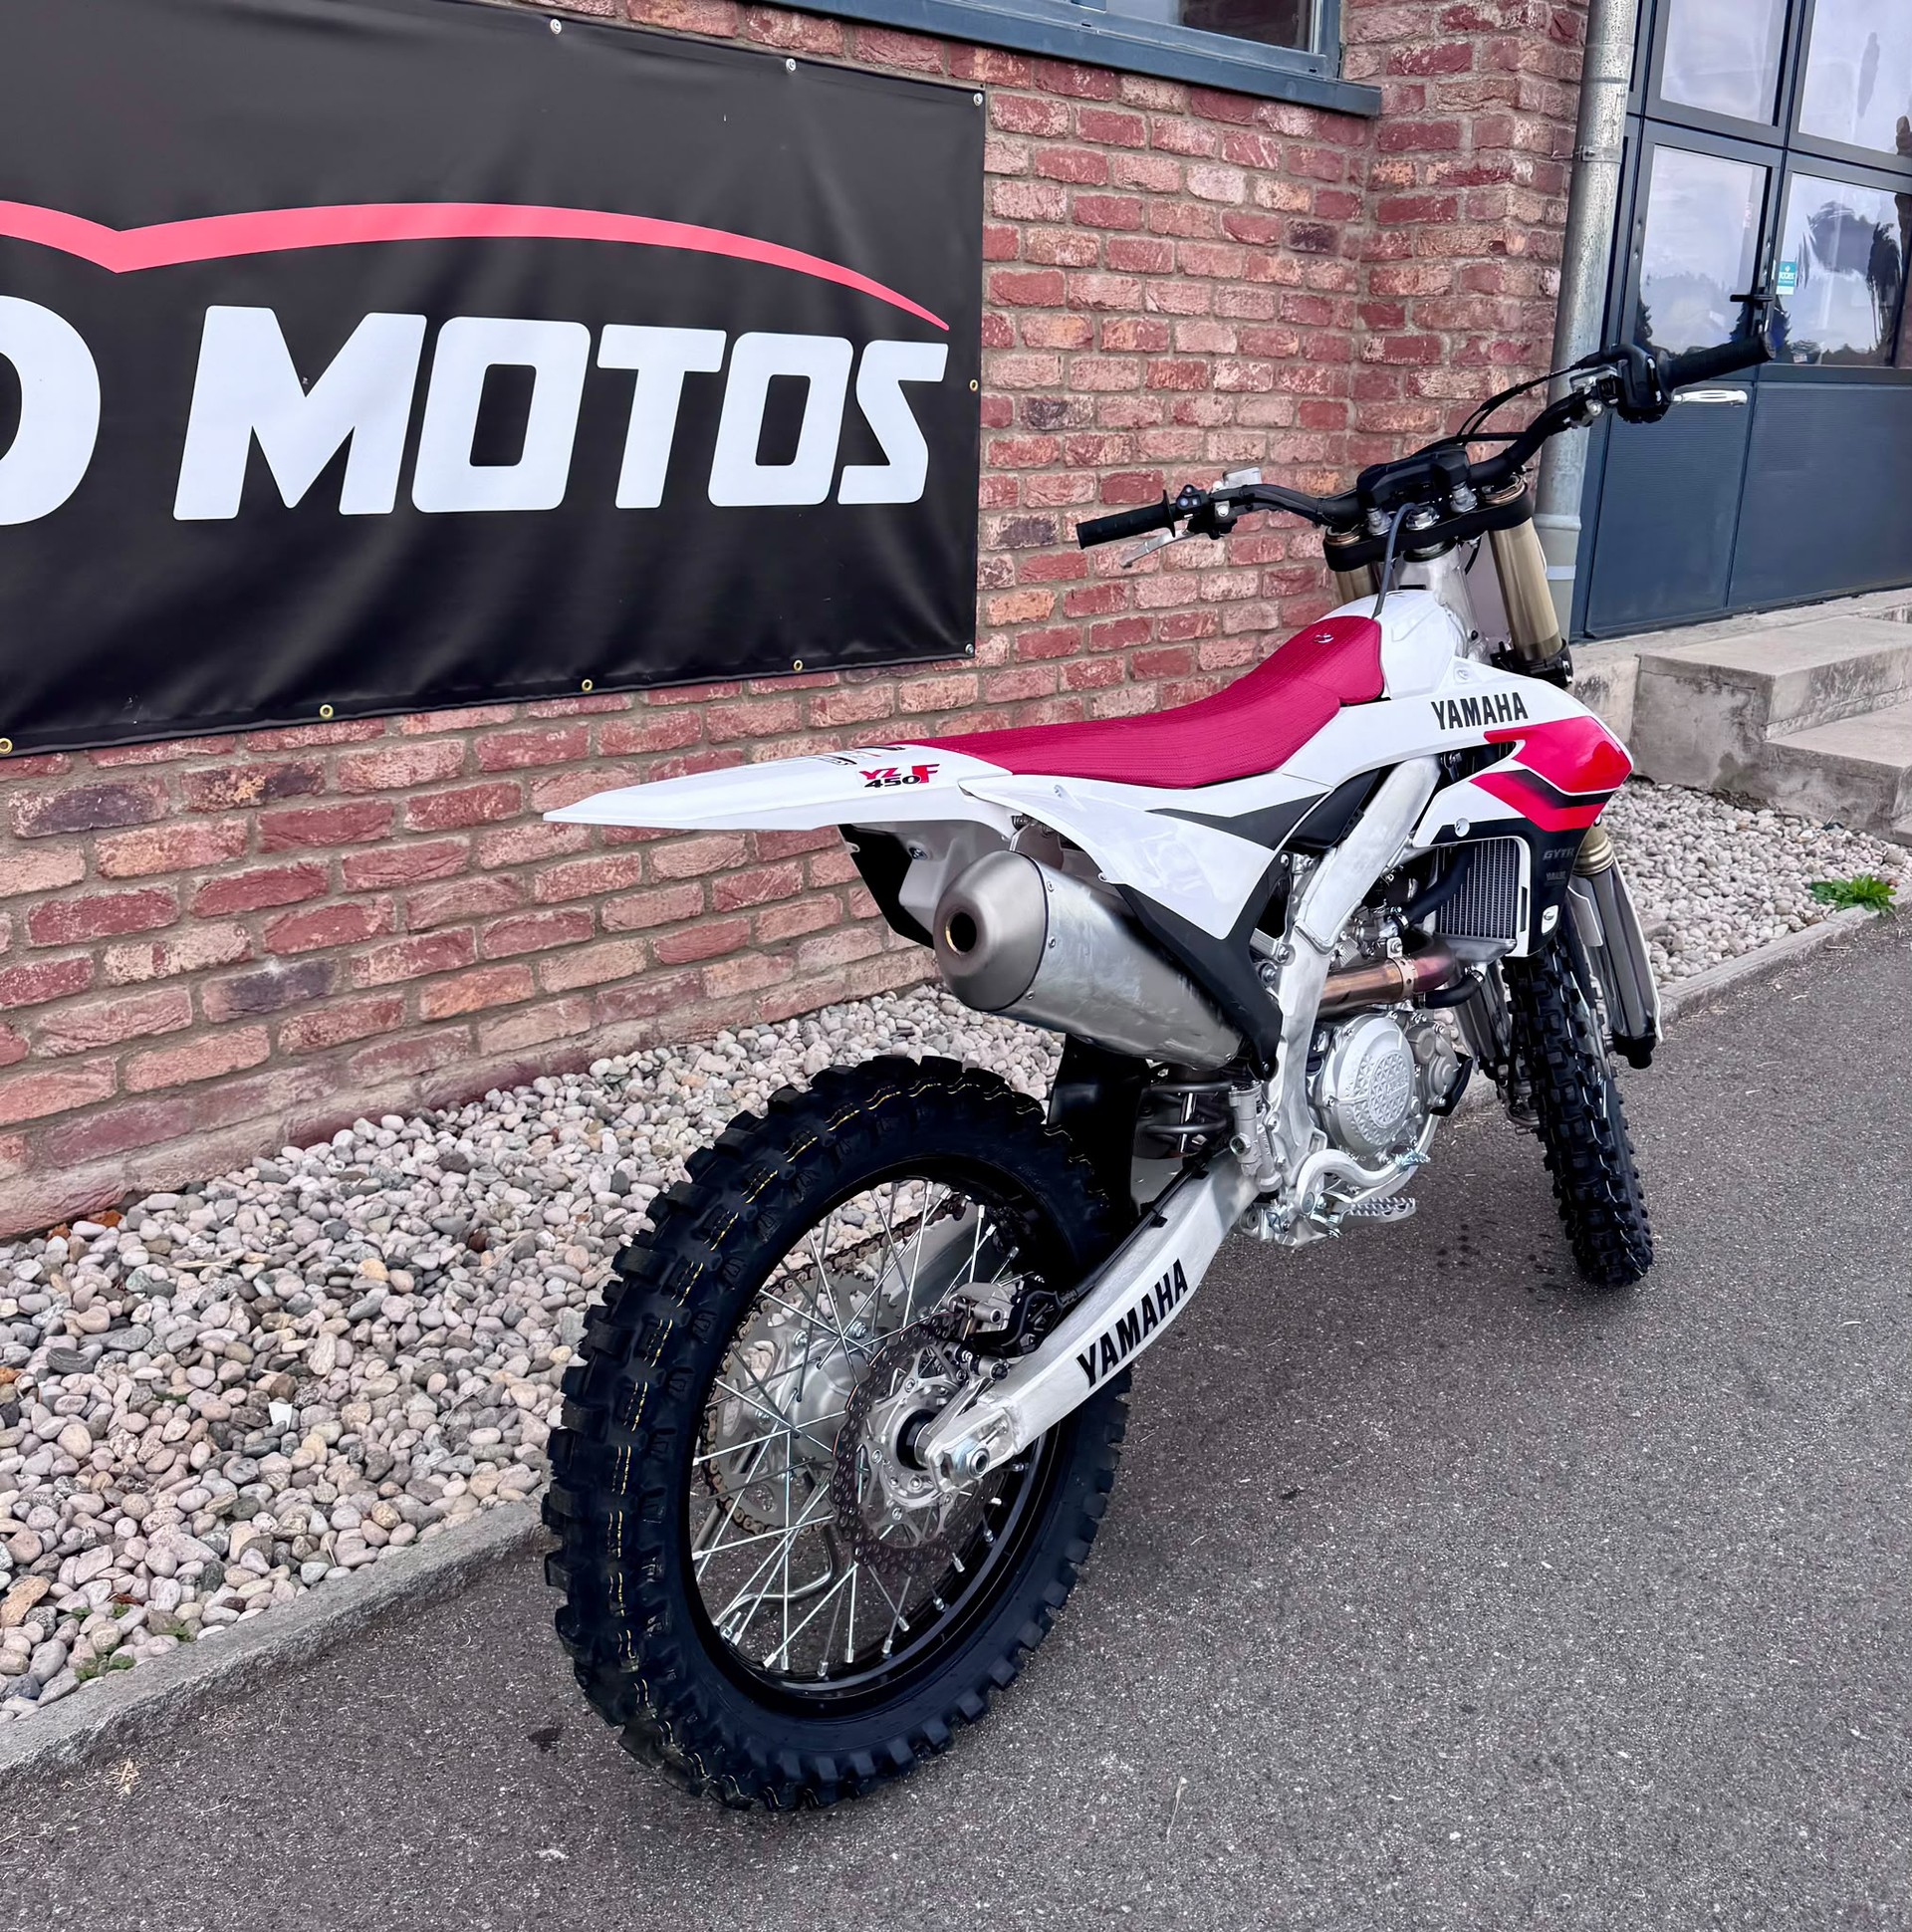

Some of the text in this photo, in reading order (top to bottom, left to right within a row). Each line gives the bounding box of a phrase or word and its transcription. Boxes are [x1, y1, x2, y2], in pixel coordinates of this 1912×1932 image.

[172, 305, 949, 521] MOTOS
[1430, 691, 1529, 730] YAMAHA
[858, 767, 902, 780] YZ
[1076, 1258, 1189, 1388] YAMAHA
